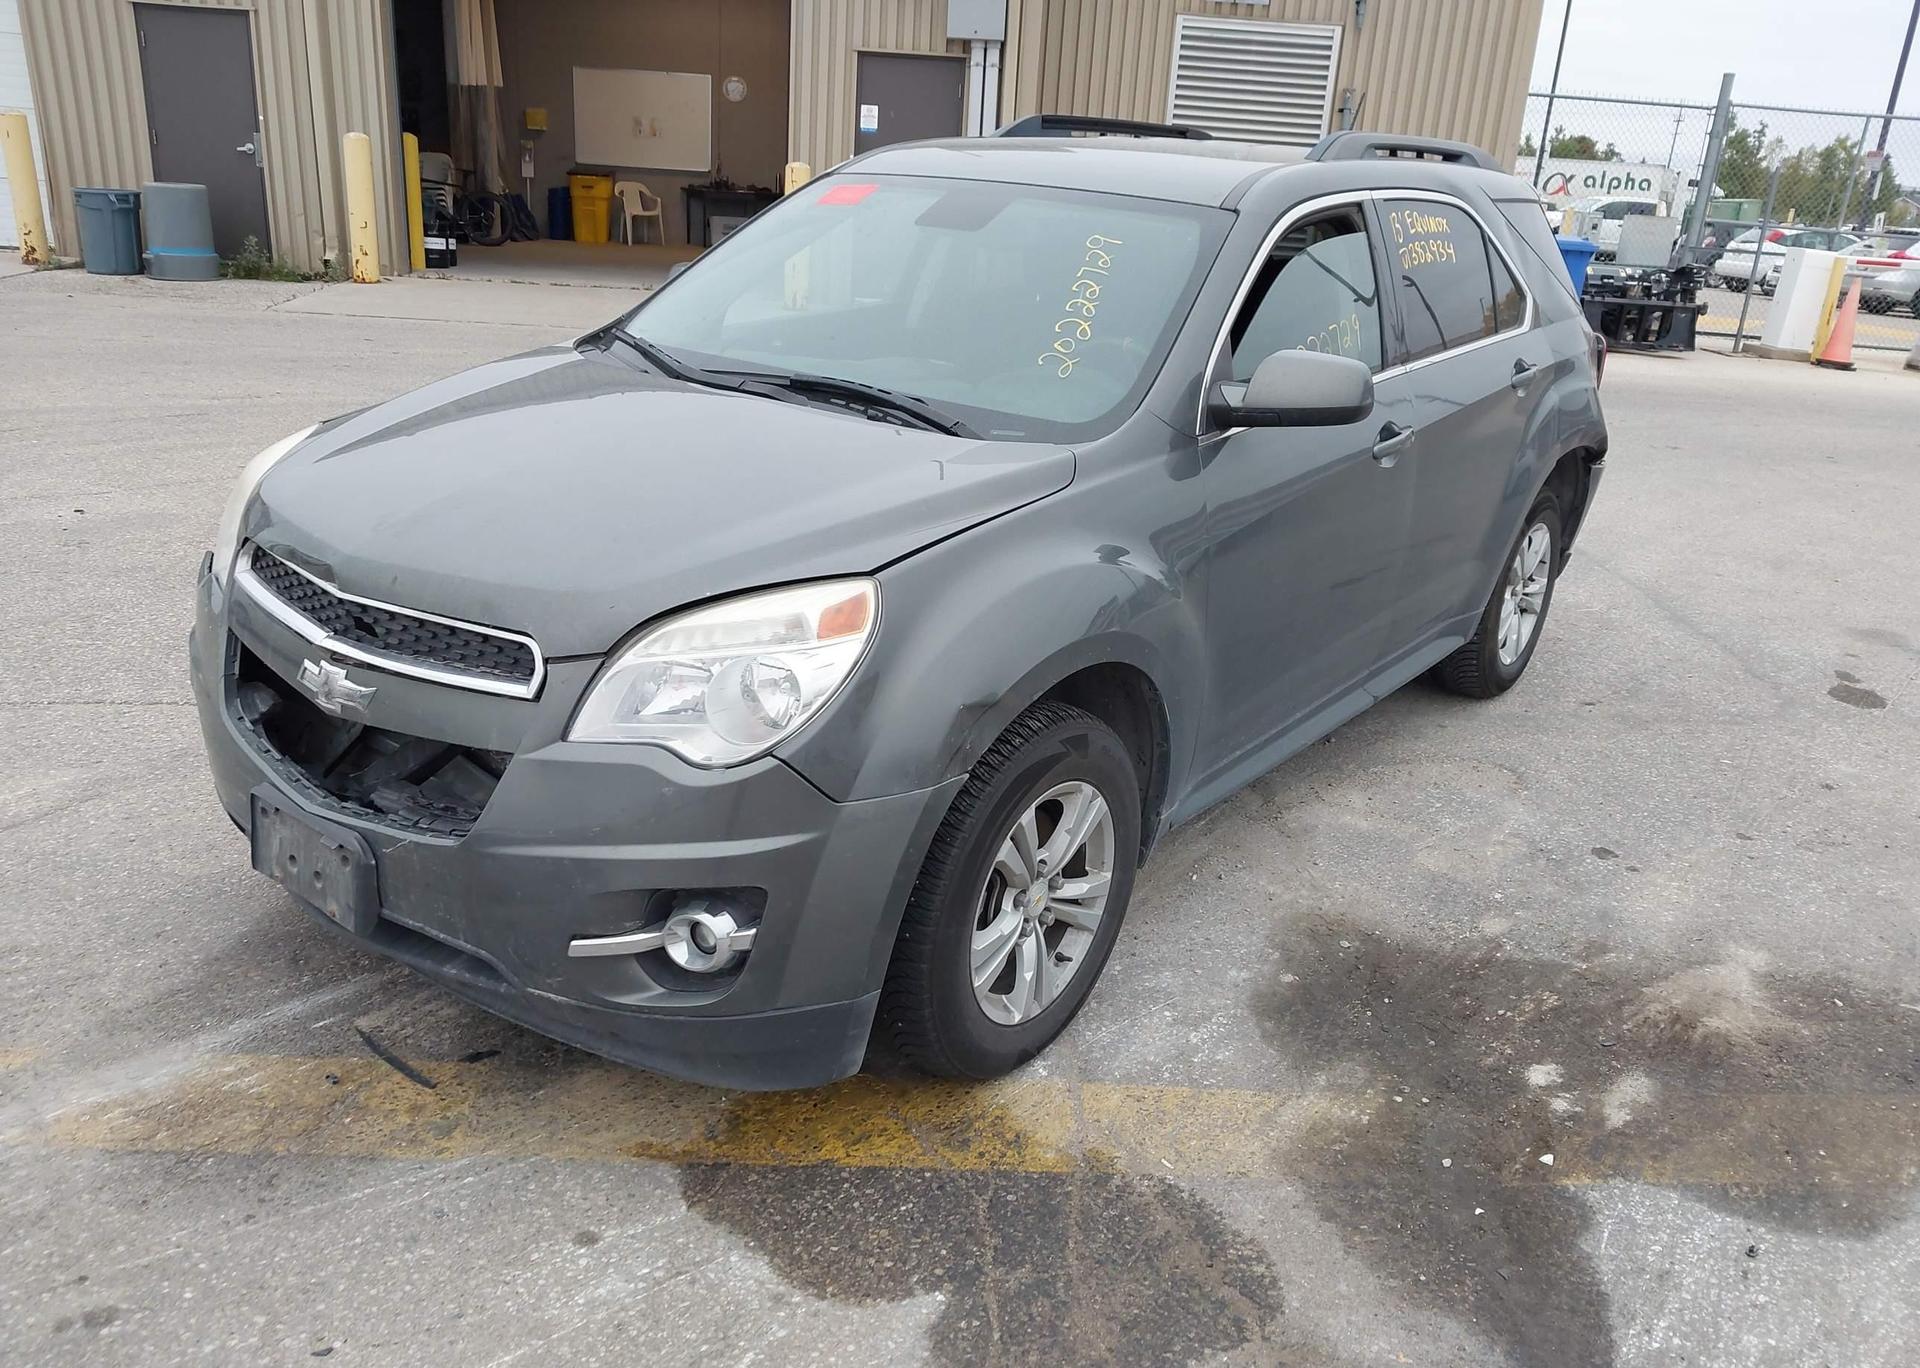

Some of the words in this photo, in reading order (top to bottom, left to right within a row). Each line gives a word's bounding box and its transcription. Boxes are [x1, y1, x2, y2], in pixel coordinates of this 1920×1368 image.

[1583, 170, 1652, 194] alpha
[1404, 210, 1451, 235] EQUINOX
[1038, 235, 1123, 378] 20222729
[1296, 313, 1361, 355] 22729
